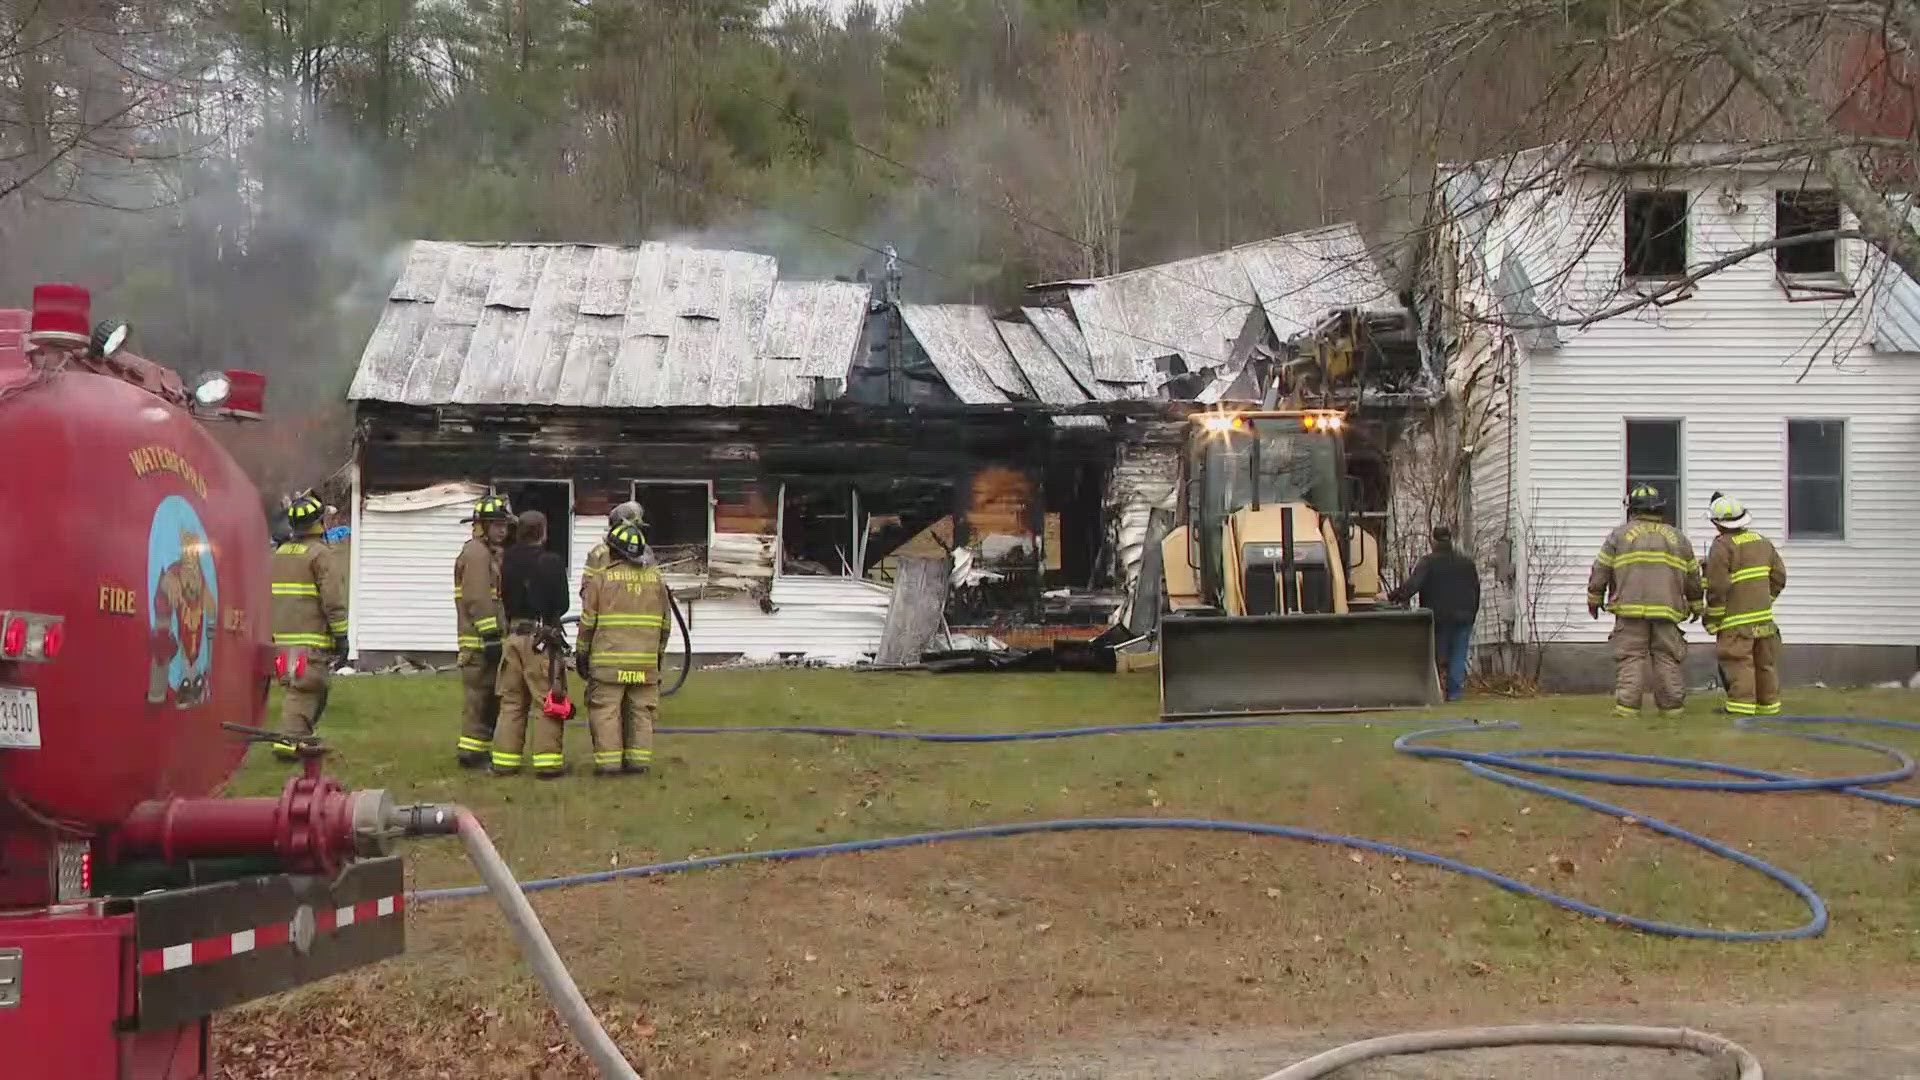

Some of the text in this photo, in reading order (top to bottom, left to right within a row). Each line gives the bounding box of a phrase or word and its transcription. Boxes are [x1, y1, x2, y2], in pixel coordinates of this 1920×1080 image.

[128, 446, 207, 500] WATERFORD
[99, 585, 136, 614] FIRE
[0, 701, 32, 732] 3-910
